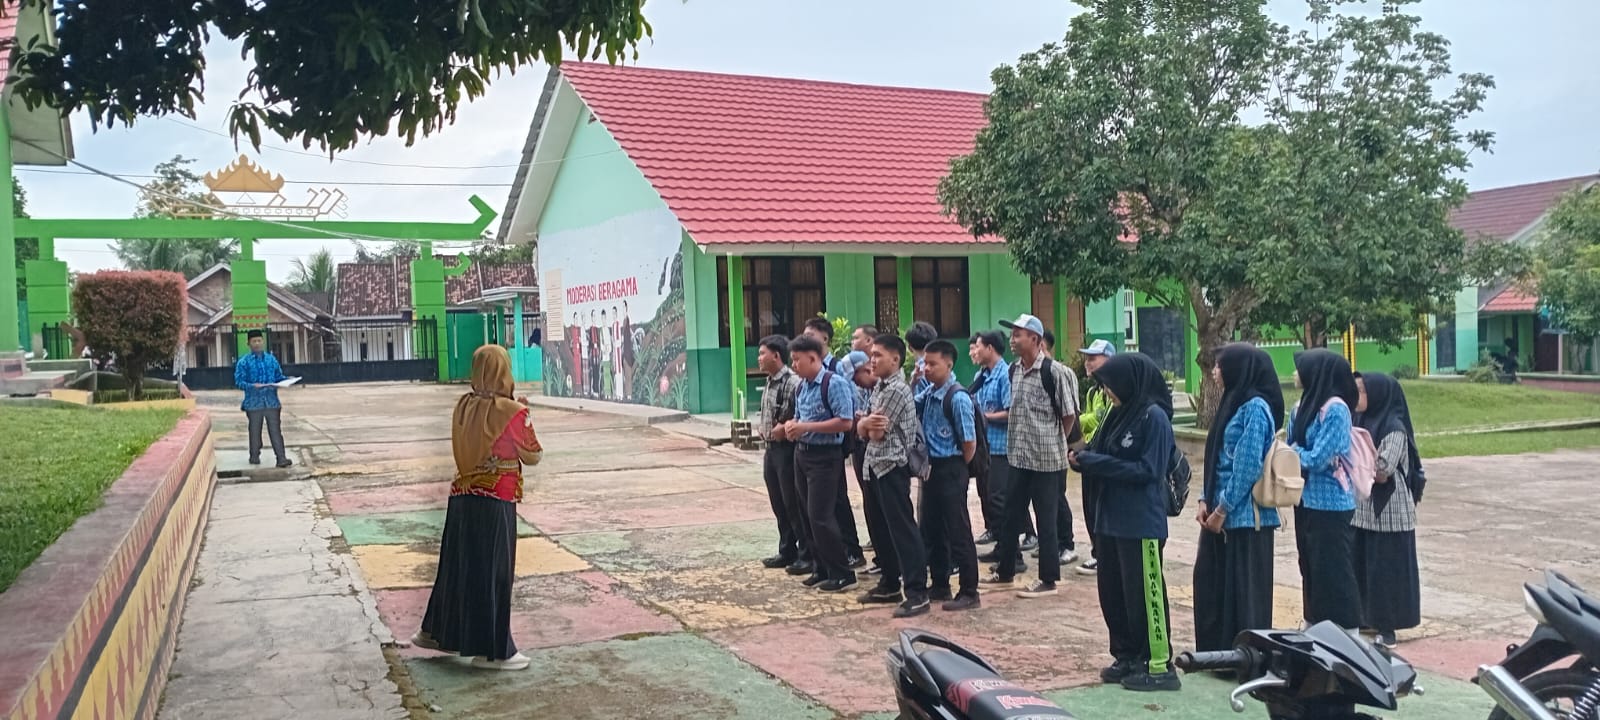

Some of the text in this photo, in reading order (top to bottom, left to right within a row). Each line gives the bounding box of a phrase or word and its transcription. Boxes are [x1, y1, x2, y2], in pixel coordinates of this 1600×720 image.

[566, 276, 638, 304] MODERASI BERAGAMA
[1148, 573, 1158, 597] WAY
[1151, 601, 1162, 641] KANAN
